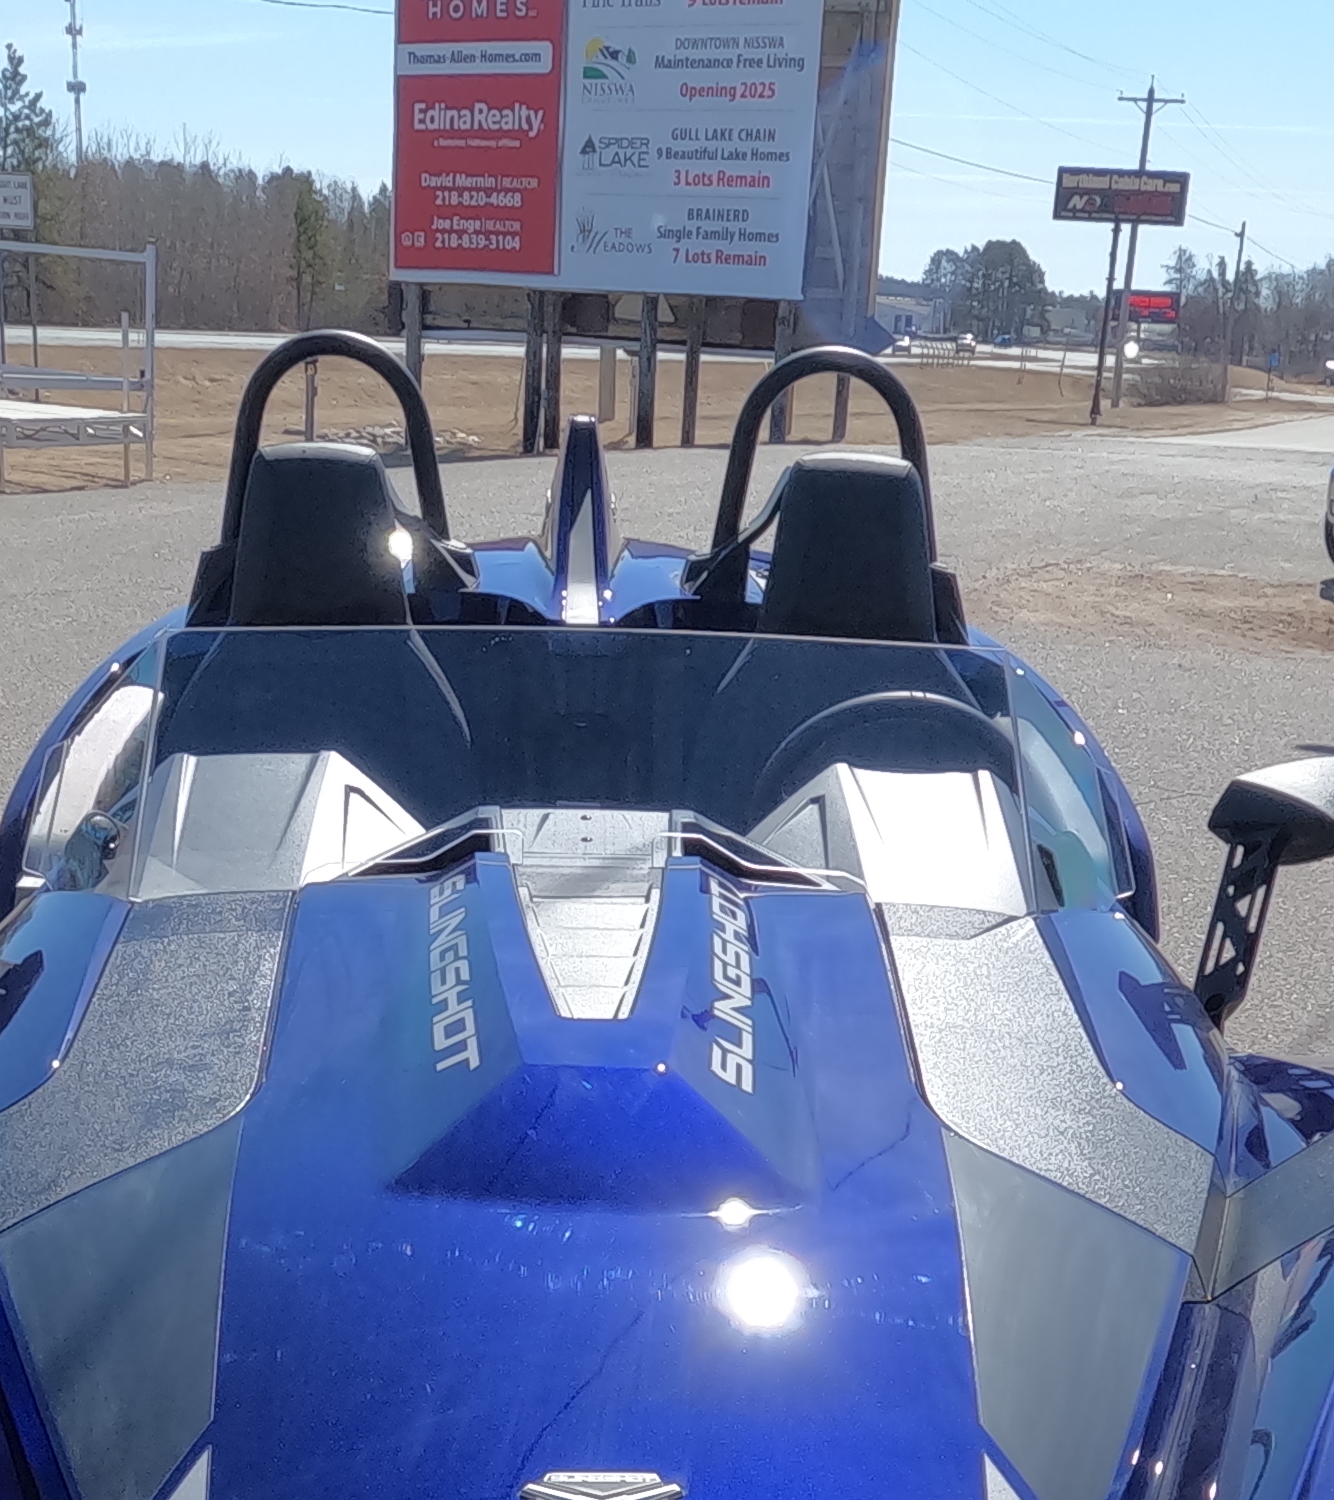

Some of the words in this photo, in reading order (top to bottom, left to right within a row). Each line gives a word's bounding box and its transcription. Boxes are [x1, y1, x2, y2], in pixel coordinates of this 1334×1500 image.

[428, 0, 528, 19] HOMES
[675, 37, 739, 50] DOWNTOWN
[743, 36, 785, 50] NISSWA
[654, 55, 733, 69] Maintenance
[736, 54, 763, 69] Free
[767, 54, 805, 72] Living
[582, 82, 635, 97] NISSWA
[680, 82, 737, 101] Opening
[739, 82, 775, 98] 2025
[671, 127, 701, 141] GULL
[705, 128, 734, 142] LAKE
[738, 128, 776, 142] CHAIN
[598, 137, 650, 149] SPIDER
[598, 151, 650, 168] LAKE
[656, 148, 664, 160] 9
[666, 147, 718, 160] Beautiful
[721, 148, 747, 161] Lake
[751, 149, 791, 162] Homes
[421, 173, 453, 187] David
[673, 170, 681, 186] 3
[685, 170, 714, 186] Lots
[717, 171, 771, 188] Remain
[435, 191, 522, 207] 218-820-4668
[431, 216, 450, 230] Joe
[687, 208, 750, 222] BRAINERD
[434, 233, 520, 250] 218-839-3104
[613, 228, 633, 239] THE
[656, 226, 693, 243] Single
[695, 227, 735, 245] Family
[738, 228, 780, 243] Homes
[672, 248, 681, 264] 7
[685, 248, 712, 264] Lots
[716, 250, 767, 267] Remain
[429, 873, 481, 1073] SLINGSHOT
[709, 878, 756, 1096] SLINGSHOT
